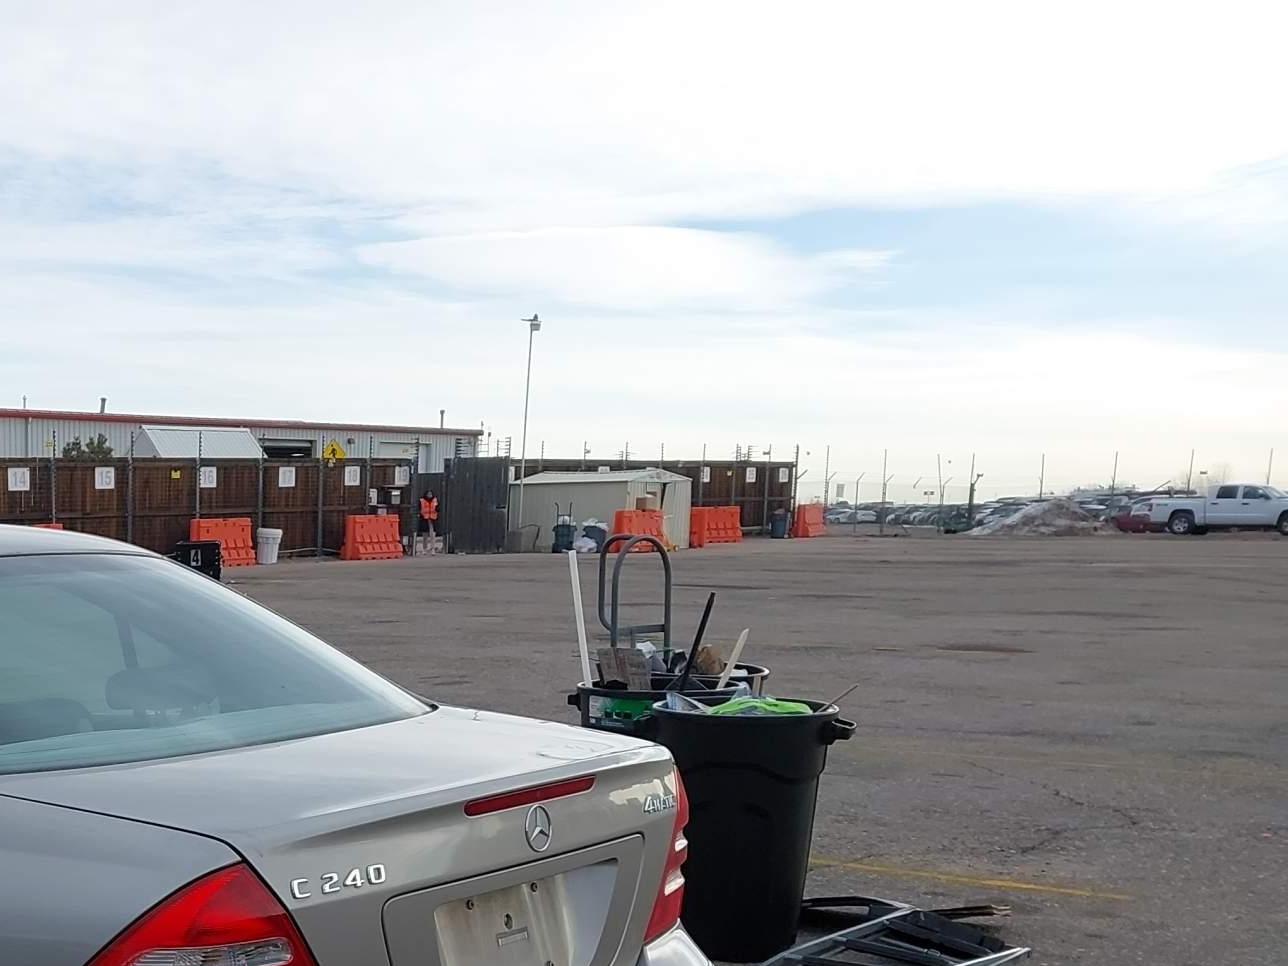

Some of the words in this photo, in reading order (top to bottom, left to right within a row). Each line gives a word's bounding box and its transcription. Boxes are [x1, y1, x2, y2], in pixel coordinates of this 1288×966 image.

[12, 472, 26, 487] 14
[99, 471, 112, 485] 15
[202, 470, 214, 484] 16
[192, 550, 200, 565] 4
[291, 878, 312, 899] C
[321, 863, 386, 894] 240
